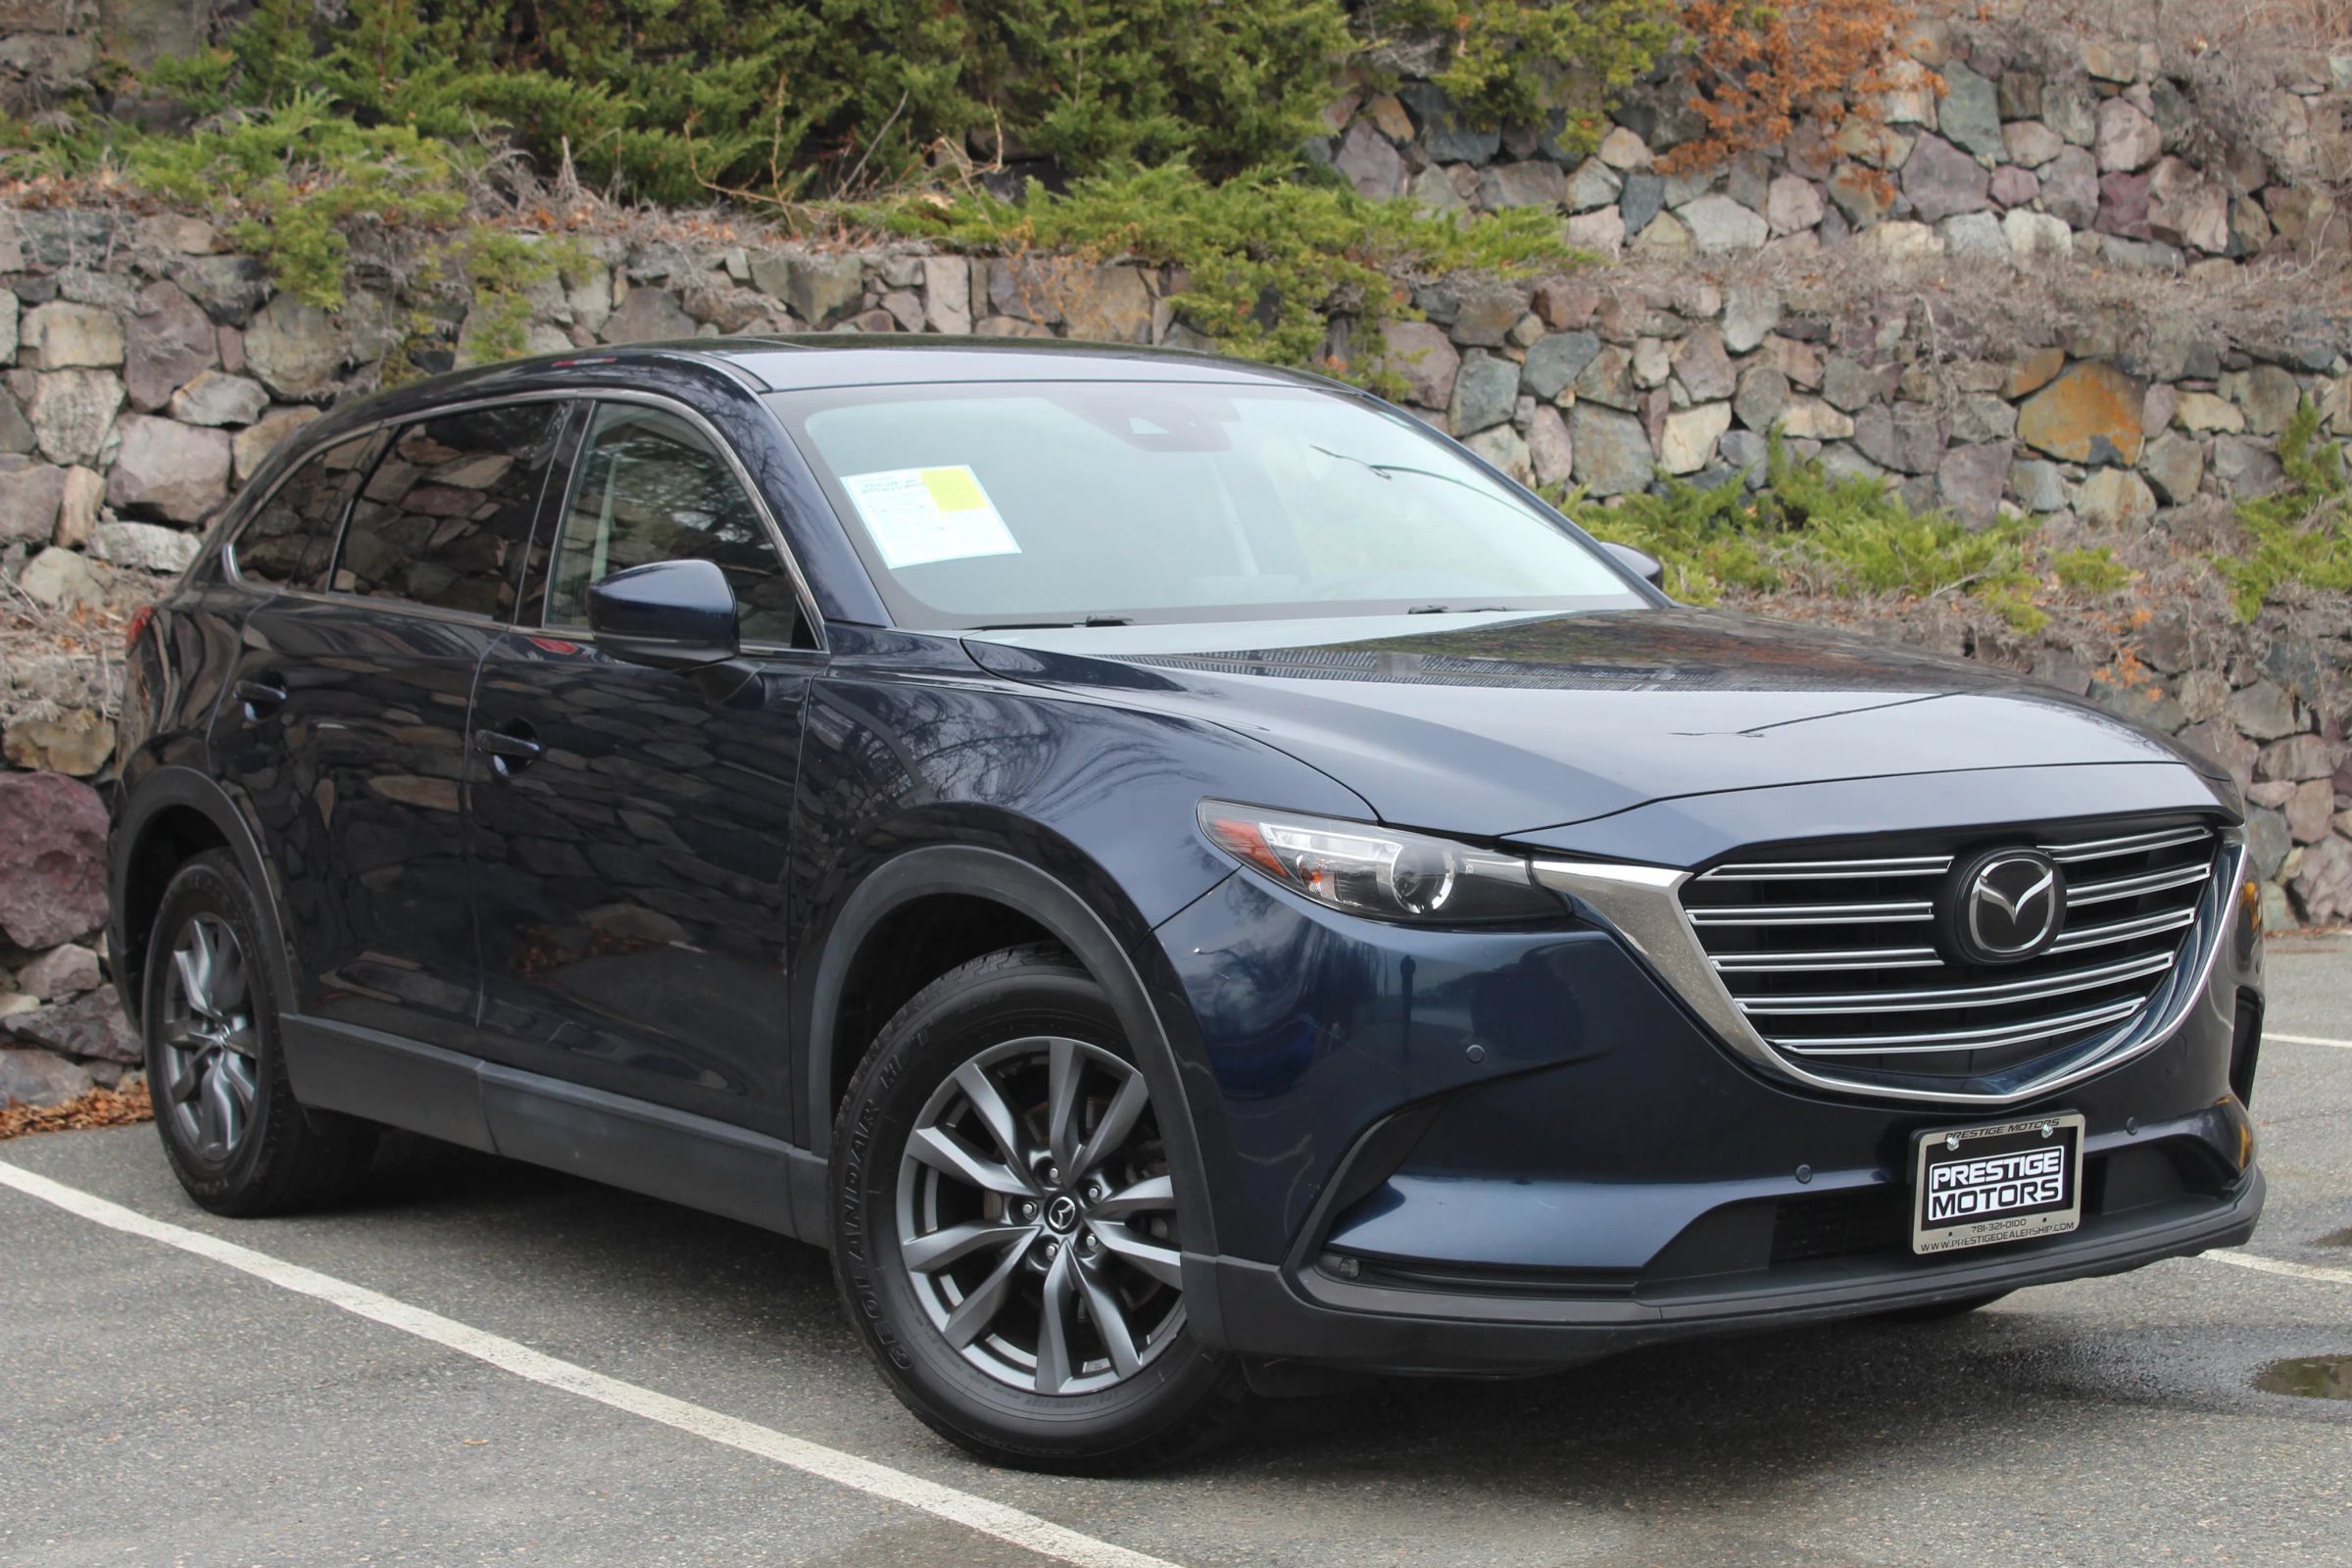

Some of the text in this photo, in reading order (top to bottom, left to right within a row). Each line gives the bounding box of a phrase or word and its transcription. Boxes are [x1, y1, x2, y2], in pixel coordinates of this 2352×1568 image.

[1945, 1119, 2060, 1141] PRESTIGE MOTORS
[1933, 1152, 2060, 1190] PRESTIGE
[1932, 1179, 2059, 1218] MOTORS
[1921, 1222, 2074, 1251] WWW.PRESTIGEDEALERSHIP.COM
[1971, 1219, 2026, 1234] 781-321-0100
